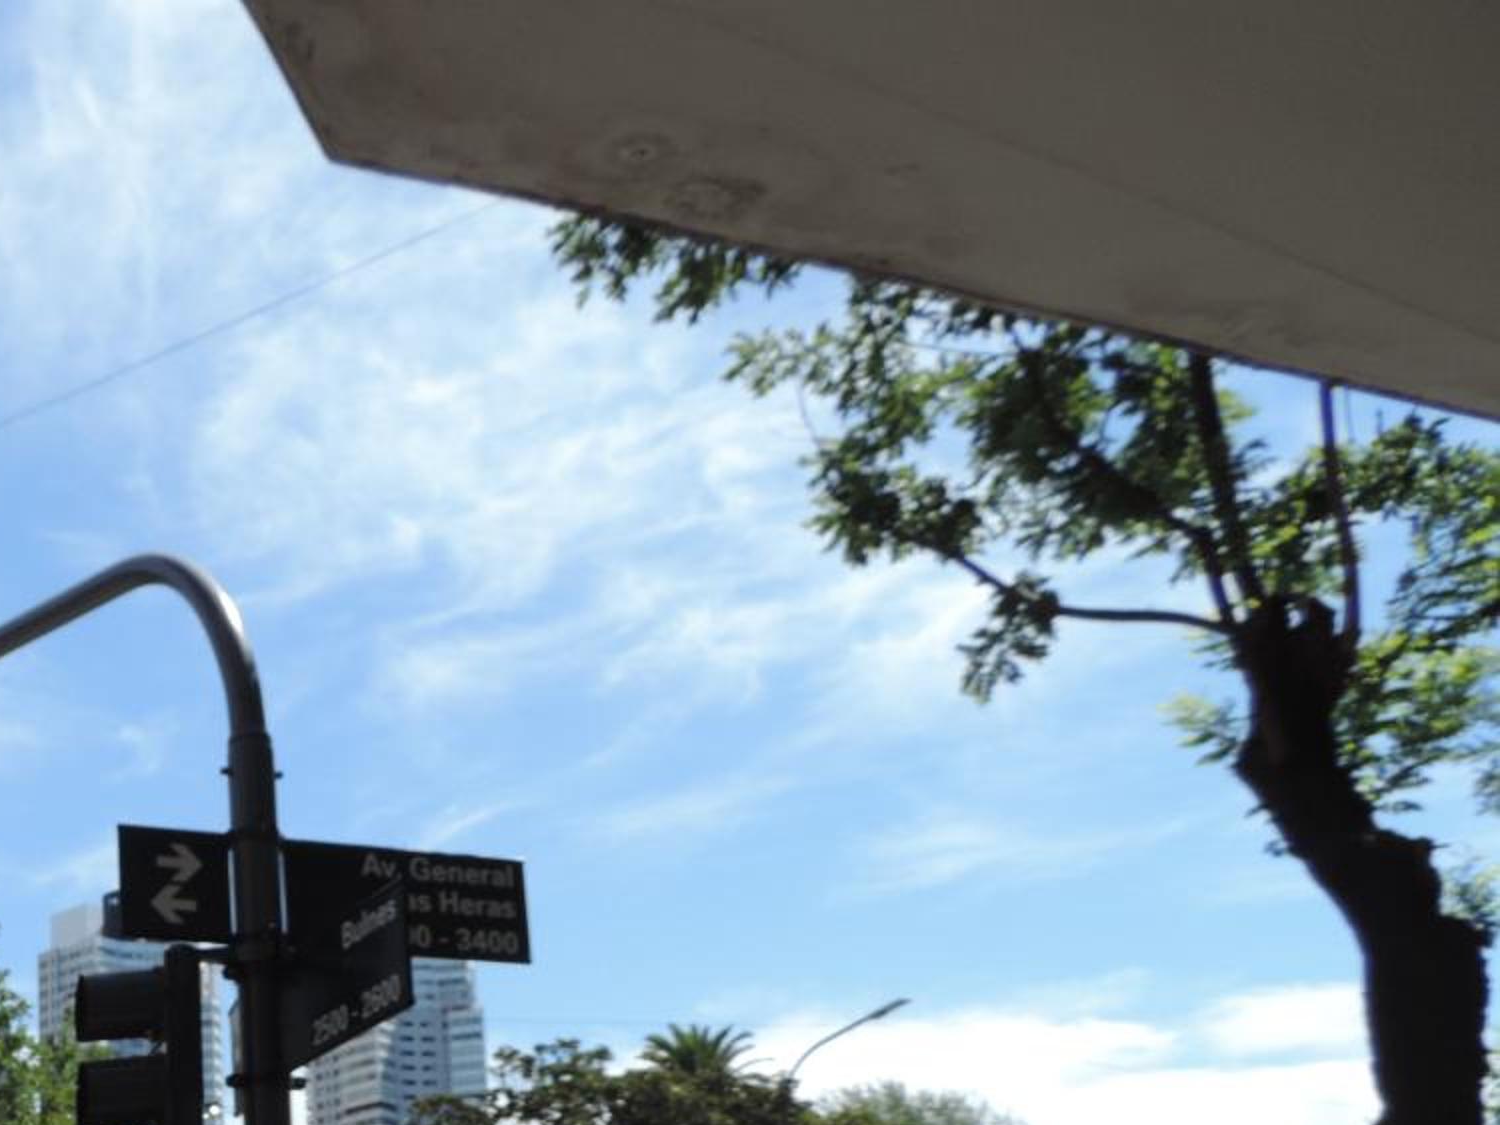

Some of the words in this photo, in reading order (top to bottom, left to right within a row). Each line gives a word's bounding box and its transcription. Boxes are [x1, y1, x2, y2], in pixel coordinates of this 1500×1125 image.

[409, 857, 516, 888] General
[438, 890, 518, 919] Heras
[341, 899, 396, 950] Bulnes
[455, 928, 519, 955] 3400
